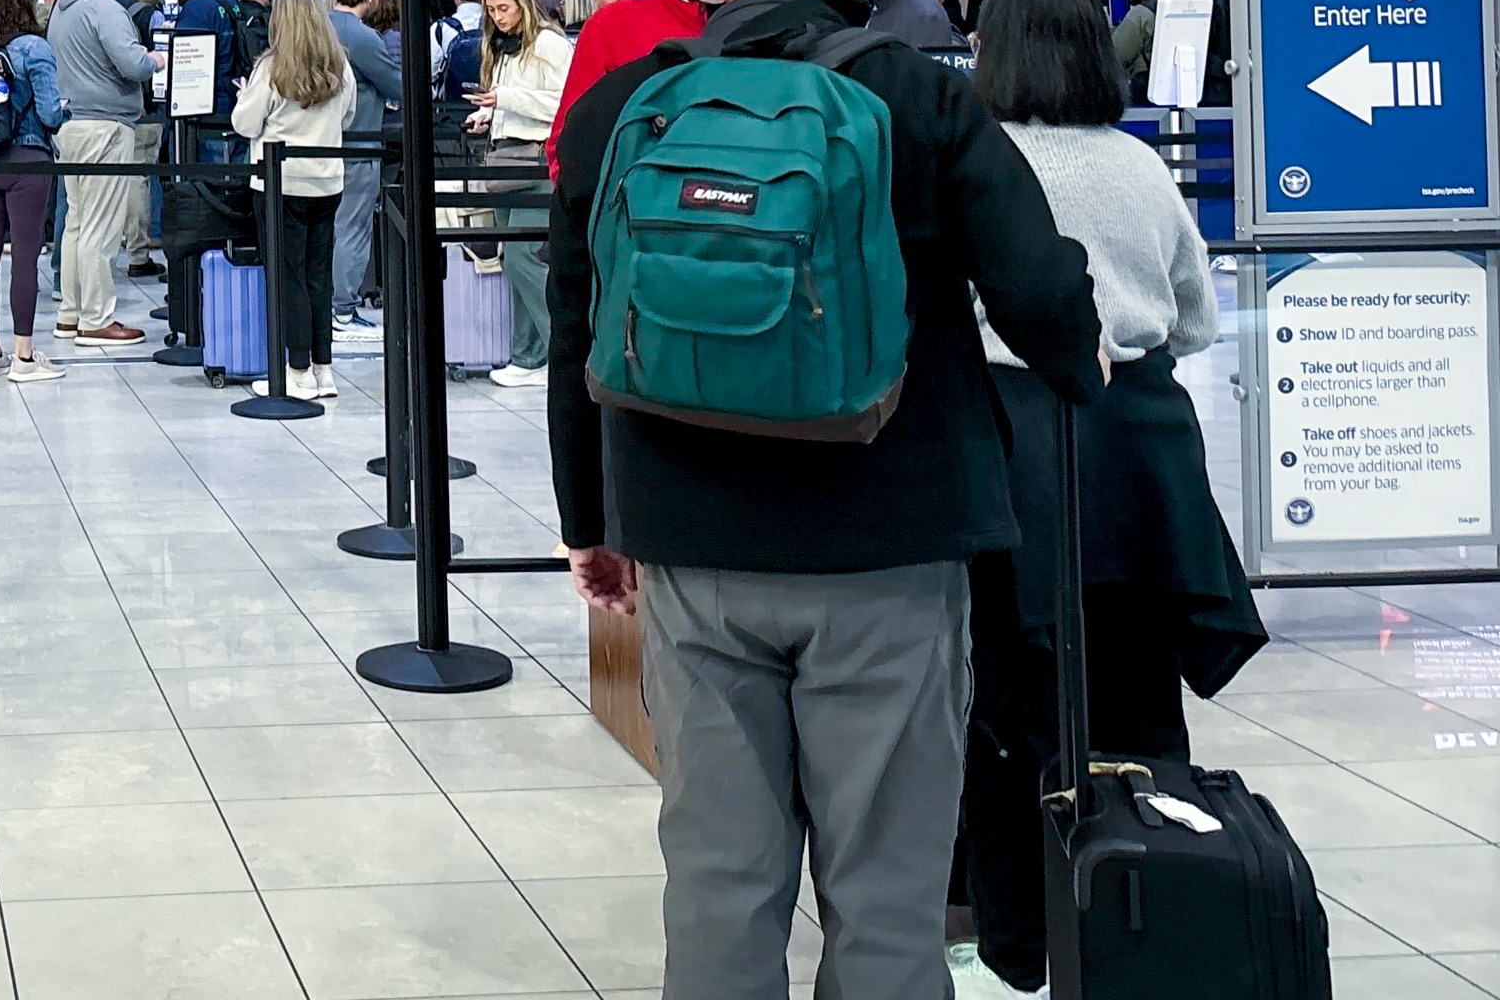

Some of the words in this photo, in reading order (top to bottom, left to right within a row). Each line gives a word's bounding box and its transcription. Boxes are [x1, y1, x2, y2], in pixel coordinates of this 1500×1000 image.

[1314, 4, 1370, 26] Enter
[1377, 3, 1427, 25] Here
[694, 188, 750, 204] EASTPAK
[1284, 295, 1328, 308] Please
[1331, 294, 1348, 307] be
[1351, 294, 1390, 308] ready
[1393, 293, 1412, 305] for
[1415, 291, 1471, 306] security:
[1299, 329, 1337, 341] Show
[1341, 328, 1355, 340] ID
[1359, 327, 1384, 339] and
[1387, 326, 1445, 342] boarding
[1448, 326, 1479, 339] pass.
[1301, 361, 1333, 374] Take
[1336, 362, 1358, 373] out
[1361, 360, 1405, 374] liquids
[1408, 359, 1432, 371] and
[1435, 358, 1450, 371] all
[1301, 378, 1372, 391] electronics
[1376, 376, 1413, 391] larger
[1417, 375, 1446, 387] than
[1302, 398, 1310, 408] a
[1313, 395, 1379, 409] cellphone.
[1302, 428, 1334, 441] Take
[1337, 427, 1357, 440] off
[1360, 427, 1397, 440] shoes
[1400, 426, 1425, 438] and
[1427, 424, 1476, 439] jackets.
[1303, 445, 1328, 457] You
[1332, 446, 1360, 459] may
[1365, 444, 1381, 456] be
[1385, 443, 1422, 455] asked
[1426, 442, 1439, 454] to
[1303, 463, 1355, 475] remove
[1358, 460, 1423, 473] additional
[1427, 459, 1462, 471] items
[1304, 478, 1336, 490] from
[1340, 479, 1371, 492] your
[1375, 477, 1400, 491] bag.
